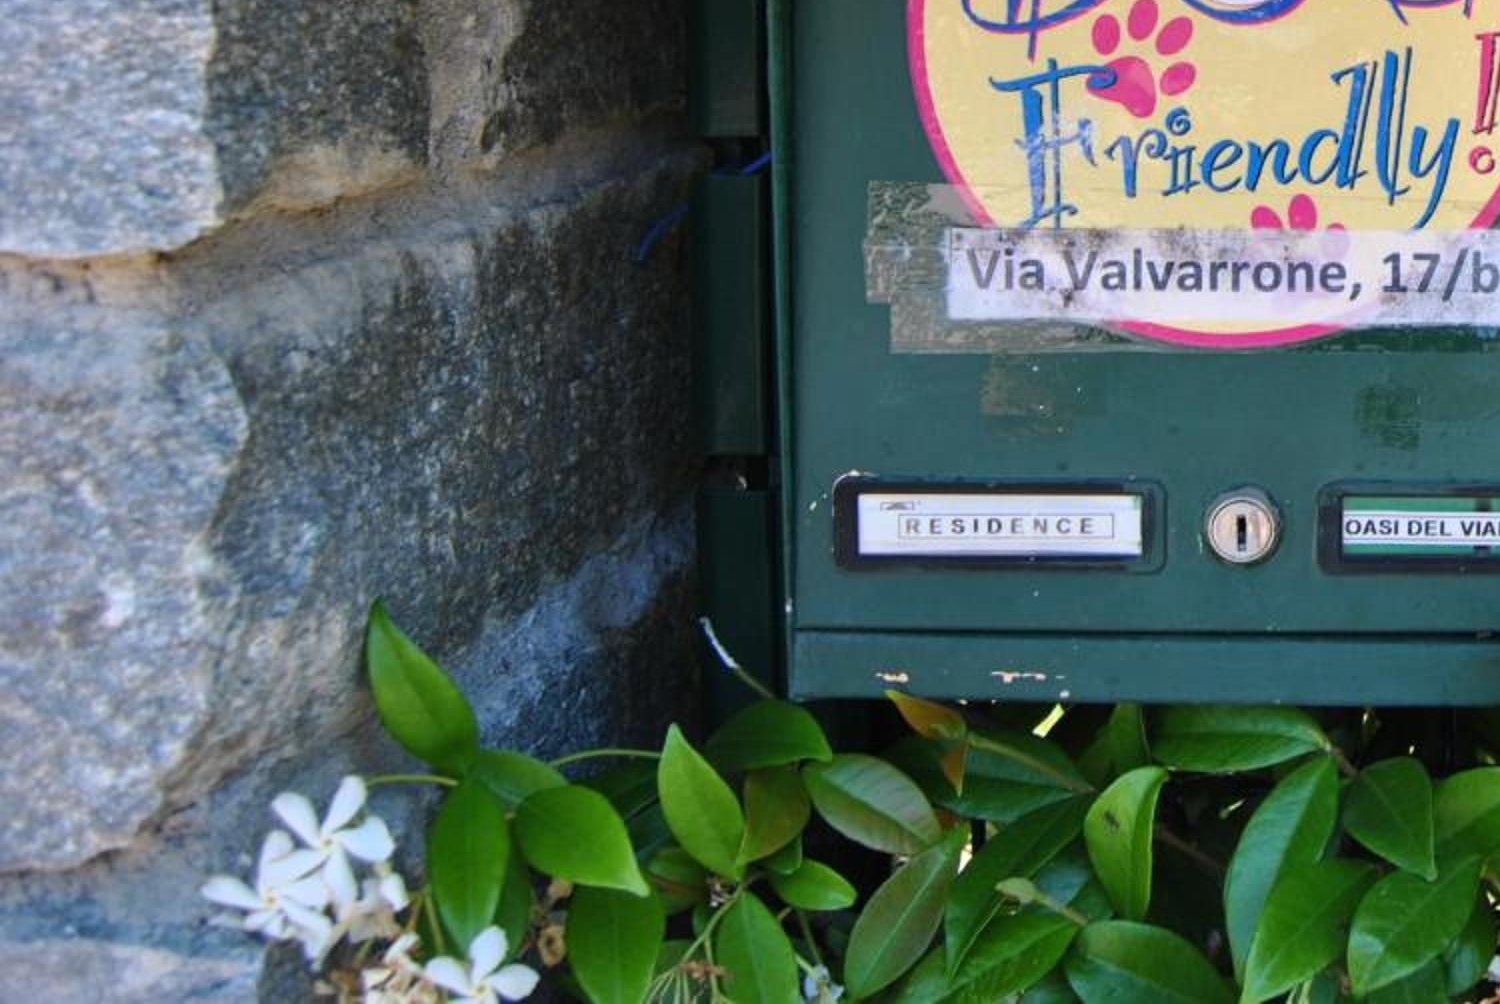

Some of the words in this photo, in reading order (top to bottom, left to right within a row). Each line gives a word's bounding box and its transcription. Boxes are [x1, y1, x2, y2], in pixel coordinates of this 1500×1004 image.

[967, 248, 1045, 292] Via
[1064, 248, 1363, 301] Valvarrone,
[1381, 249, 1500, 299] 17/b
[905, 517, 1095, 535] RESIDENCE
[1345, 519, 1399, 536] OASI
[1407, 519, 1452, 536] DEL
